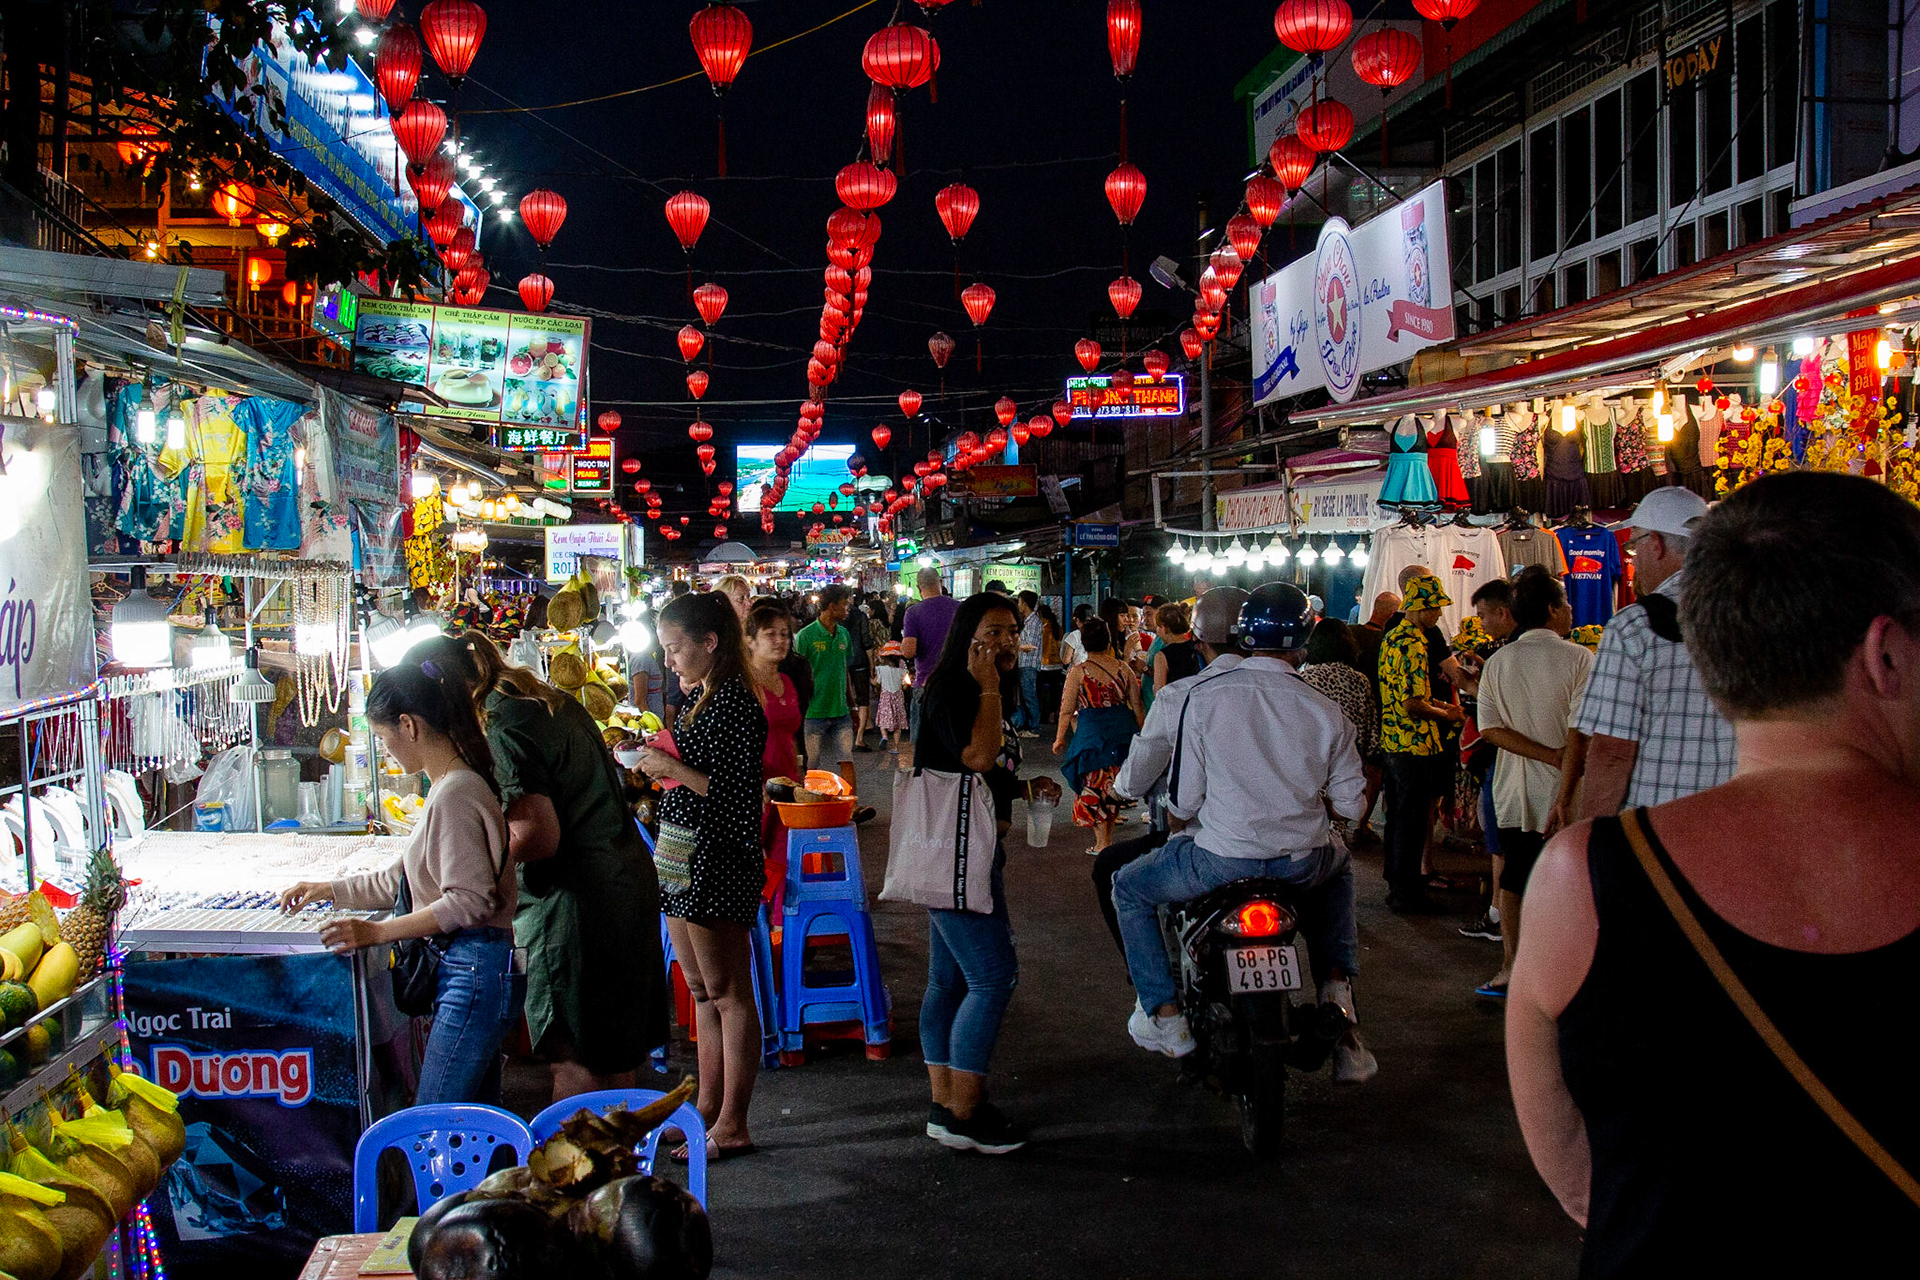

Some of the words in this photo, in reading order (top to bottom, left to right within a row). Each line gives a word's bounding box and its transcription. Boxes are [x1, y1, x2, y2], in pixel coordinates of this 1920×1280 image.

[1663, 34, 1722, 90] TODAY
[1404, 311, 1420, 332] SINCE
[1132, 389, 1178, 403] THANH
[507, 430, 570, 445] 海鲜餐厅
[577, 460, 596, 469] NGỌC
[577, 470, 599, 478] PEARLS
[1314, 496, 1321, 517] BY
[1337, 494, 1344, 516] LA
[1345, 493, 1369, 517] PRALINE
[1346, 518, 1360, 527] SINCE
[552, 532, 567, 544] Kem
[552, 551, 563, 559] ICE
[1451, 570, 1475, 579] VIETNAM
[961, 797, 969, 811] Love
[1236, 949, 1289, 969] 68-P6
[1240, 969, 1292, 990] 4830
[124, 1010, 182, 1038] Ngọc
[187, 1006, 232, 1030] Trai
[154, 1048, 311, 1105] Dương
